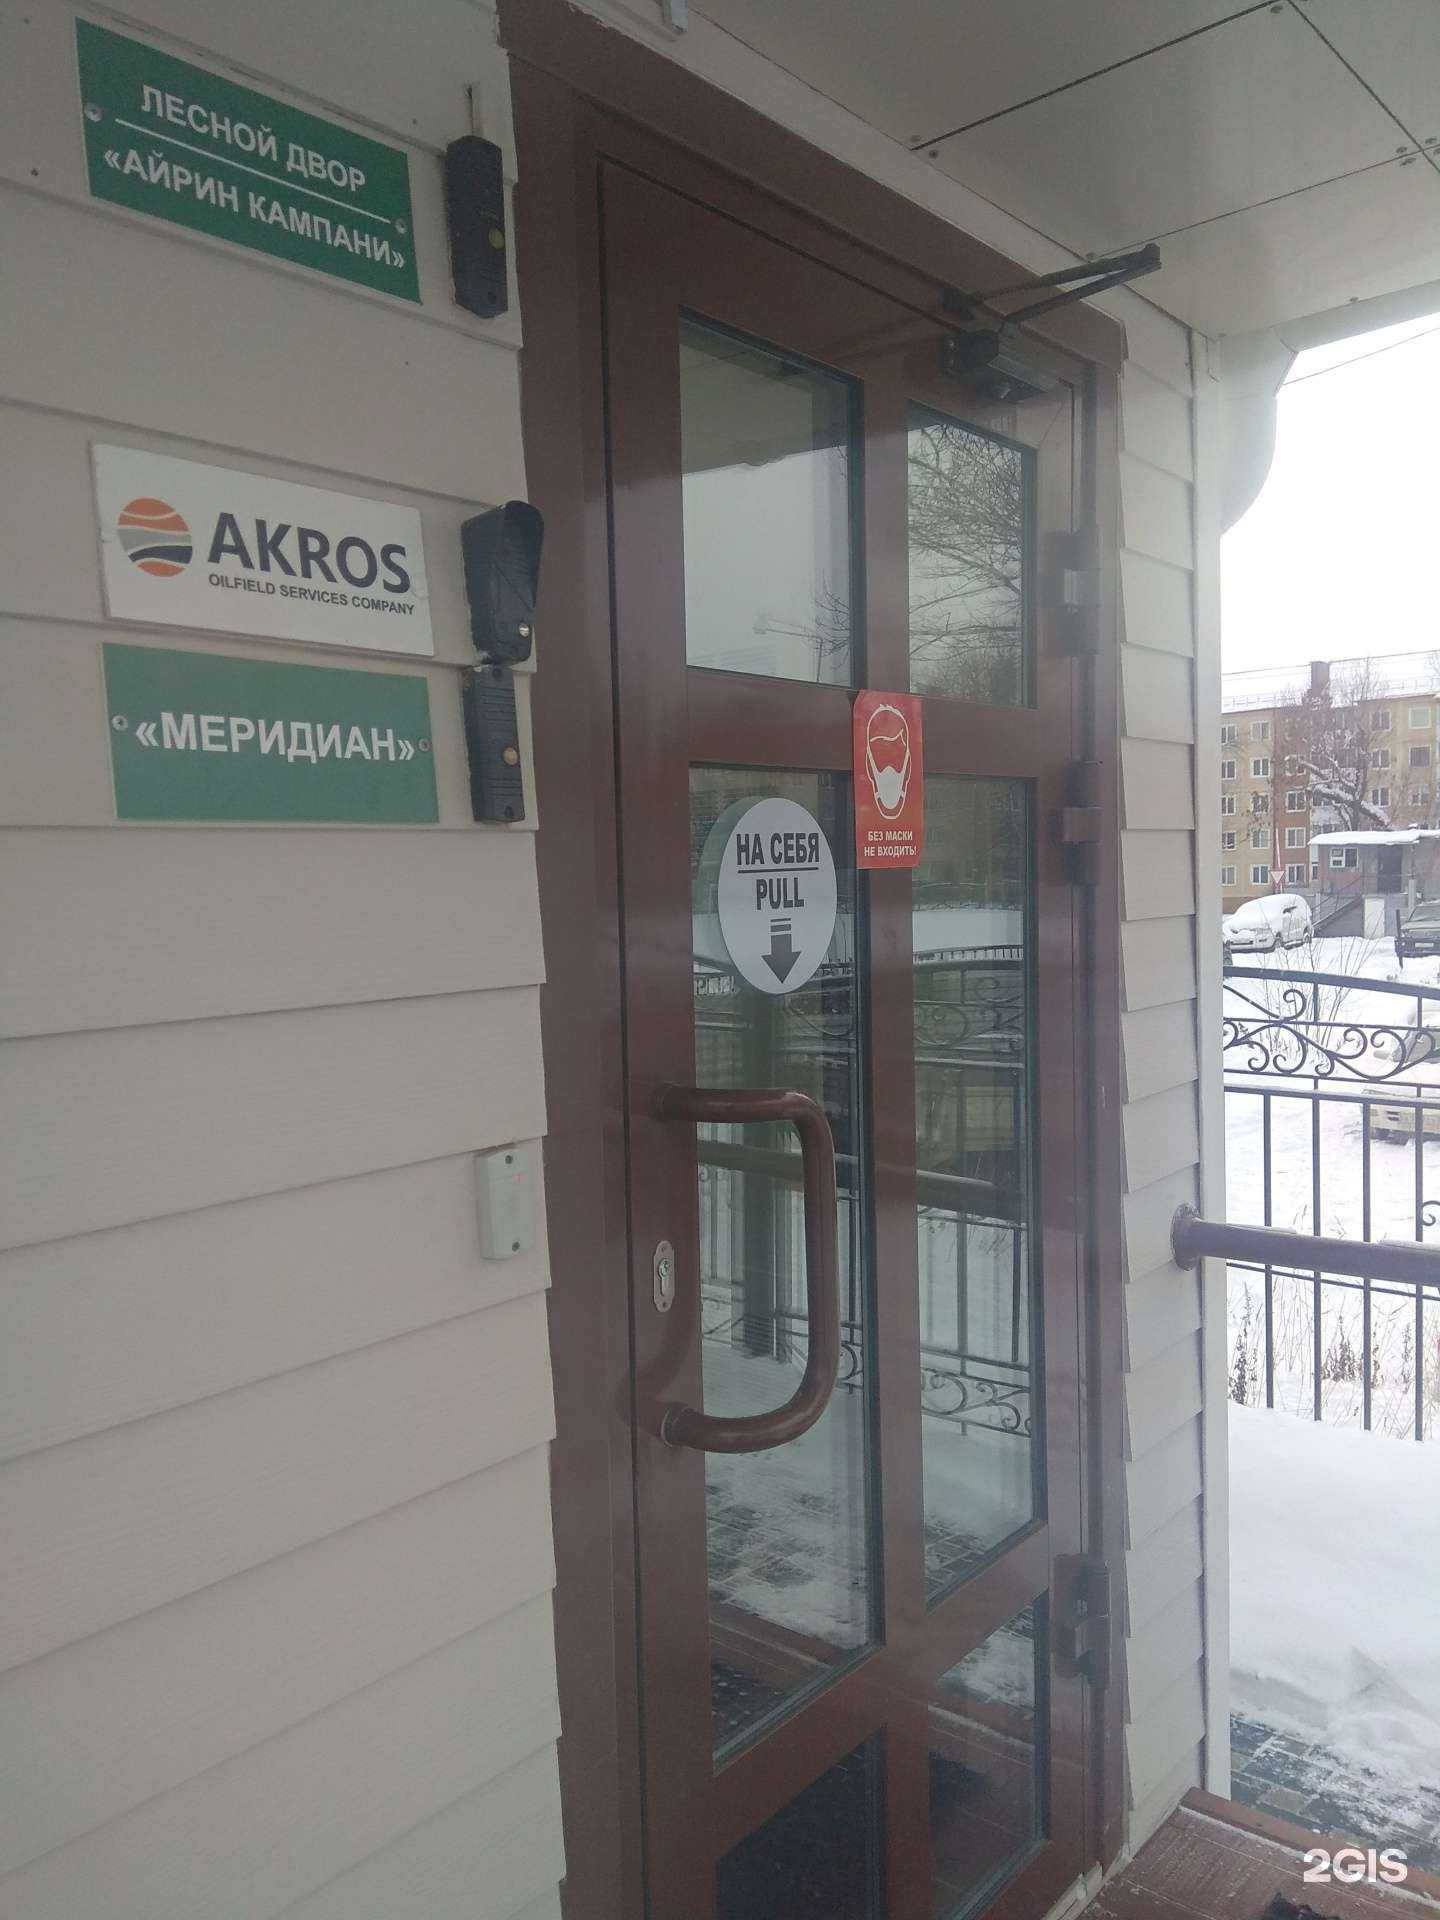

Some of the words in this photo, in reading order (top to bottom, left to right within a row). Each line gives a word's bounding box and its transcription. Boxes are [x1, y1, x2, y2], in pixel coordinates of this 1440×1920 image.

[141, 85, 278, 162] ЛЕСНОЙ
[286, 144, 367, 192] ДВОР
[104, 148, 240, 213] «АЙРИН
[248, 191, 406, 268] КАМПАНИ»
[207, 512, 412, 594] AKROS
[208, 573, 276, 596] OILFIELD
[279, 584, 349, 606] SERVICES
[351, 596, 415, 616] COMPANY
[135, 712, 415, 763] «МЕРИДИАН»
[736, 832, 765, 866] НА
[770, 832, 820, 864] СЕБЯ
[864, 846, 876, 857] НЕ
[877, 846, 917, 857] ВХОДИТЬ!
[867, 830, 883, 842] БЕЗ
[885, 830, 913, 842] МАСКИ
[756, 876, 805, 911] PULL
